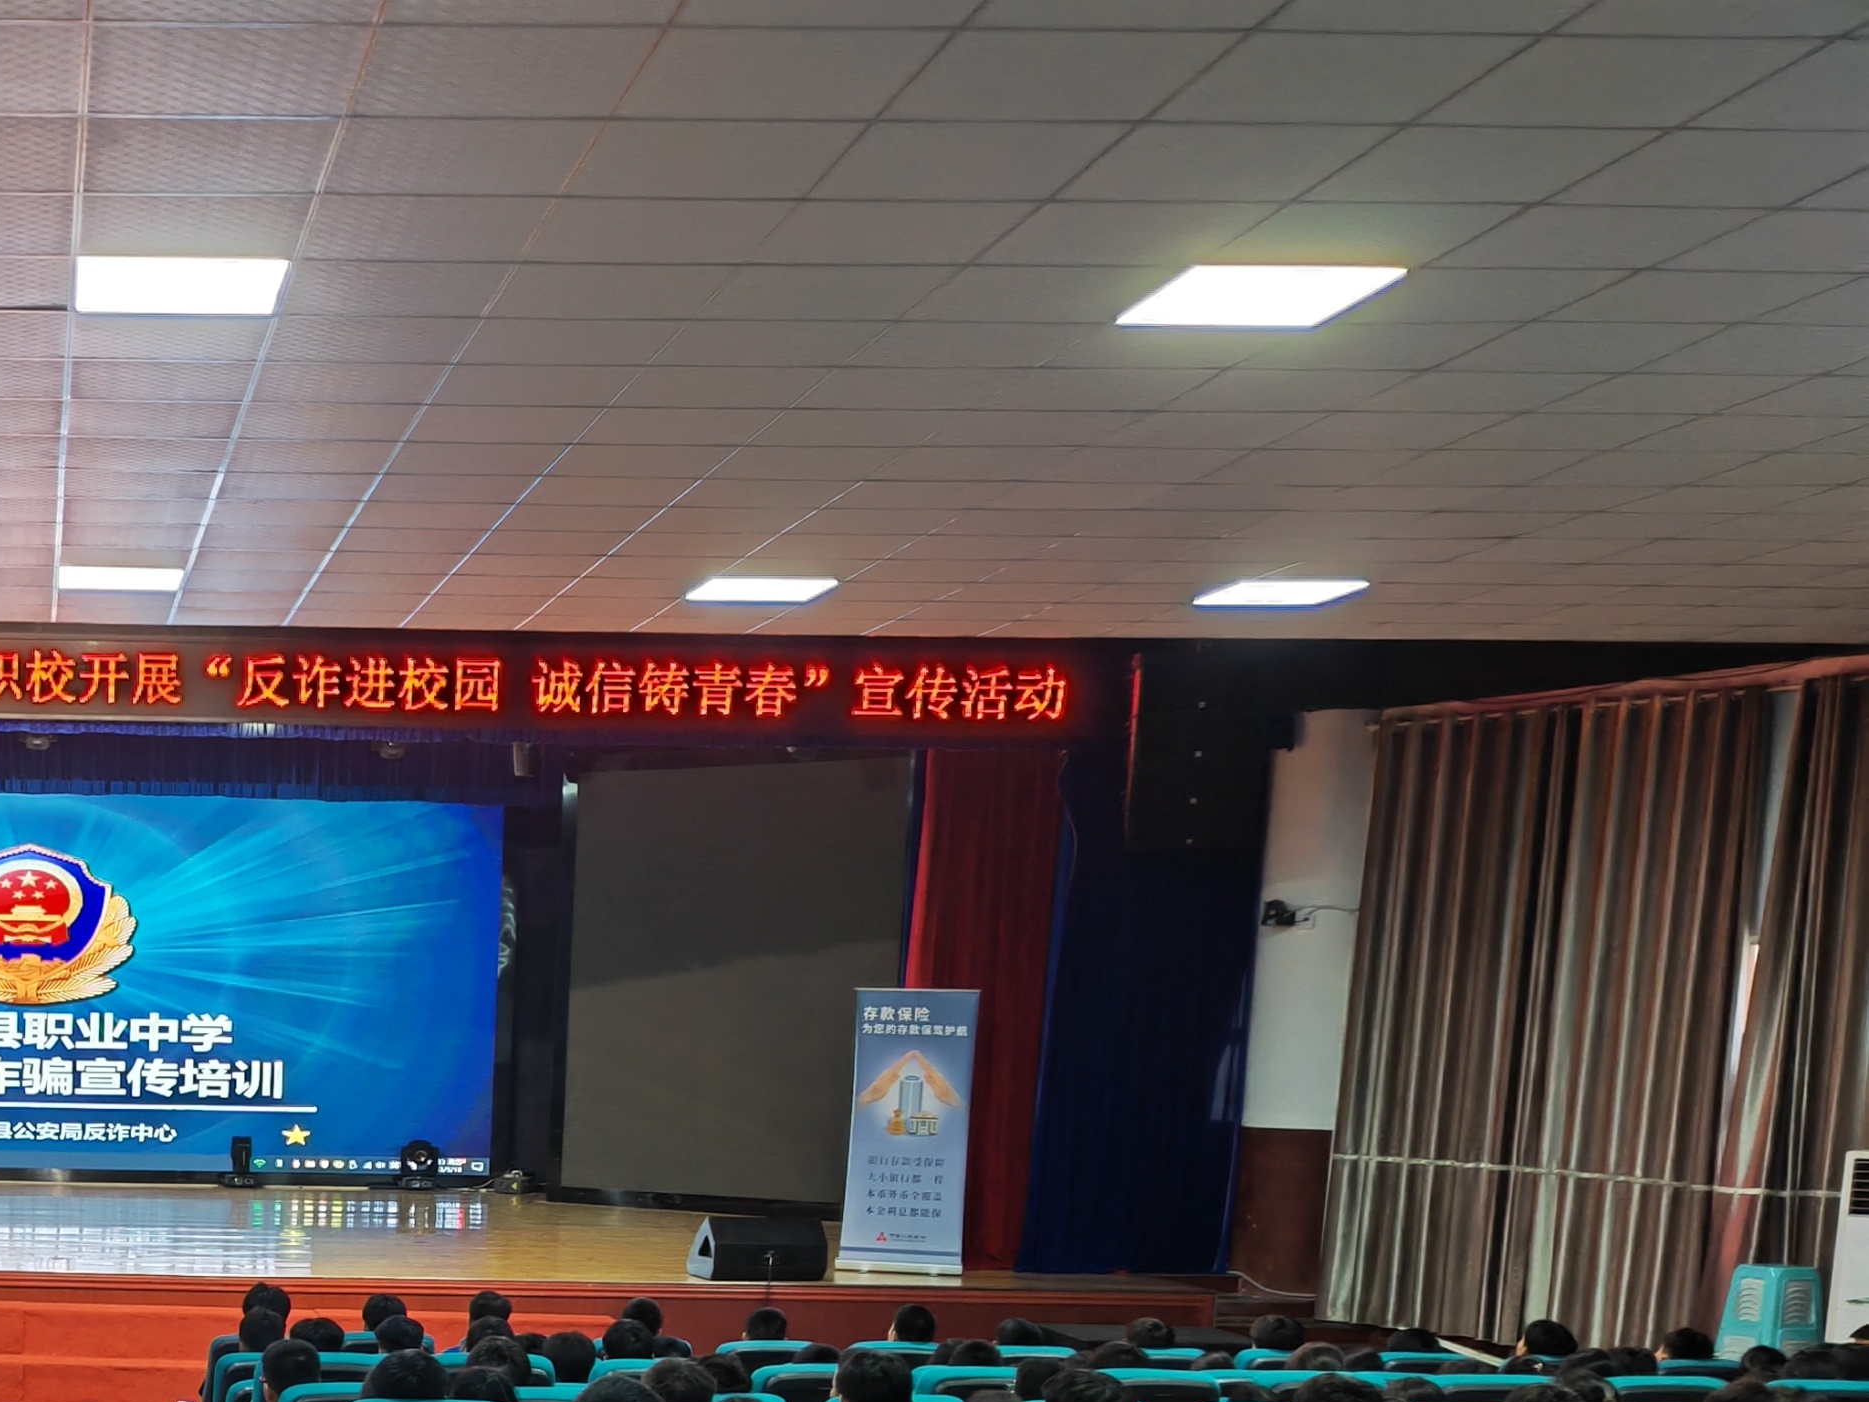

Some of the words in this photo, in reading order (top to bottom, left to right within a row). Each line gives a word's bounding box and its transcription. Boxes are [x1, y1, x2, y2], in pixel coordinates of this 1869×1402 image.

[863, 1006, 931, 1022] 存款保险
[861, 1023, 969, 1037] 为您的存款保驾护航
